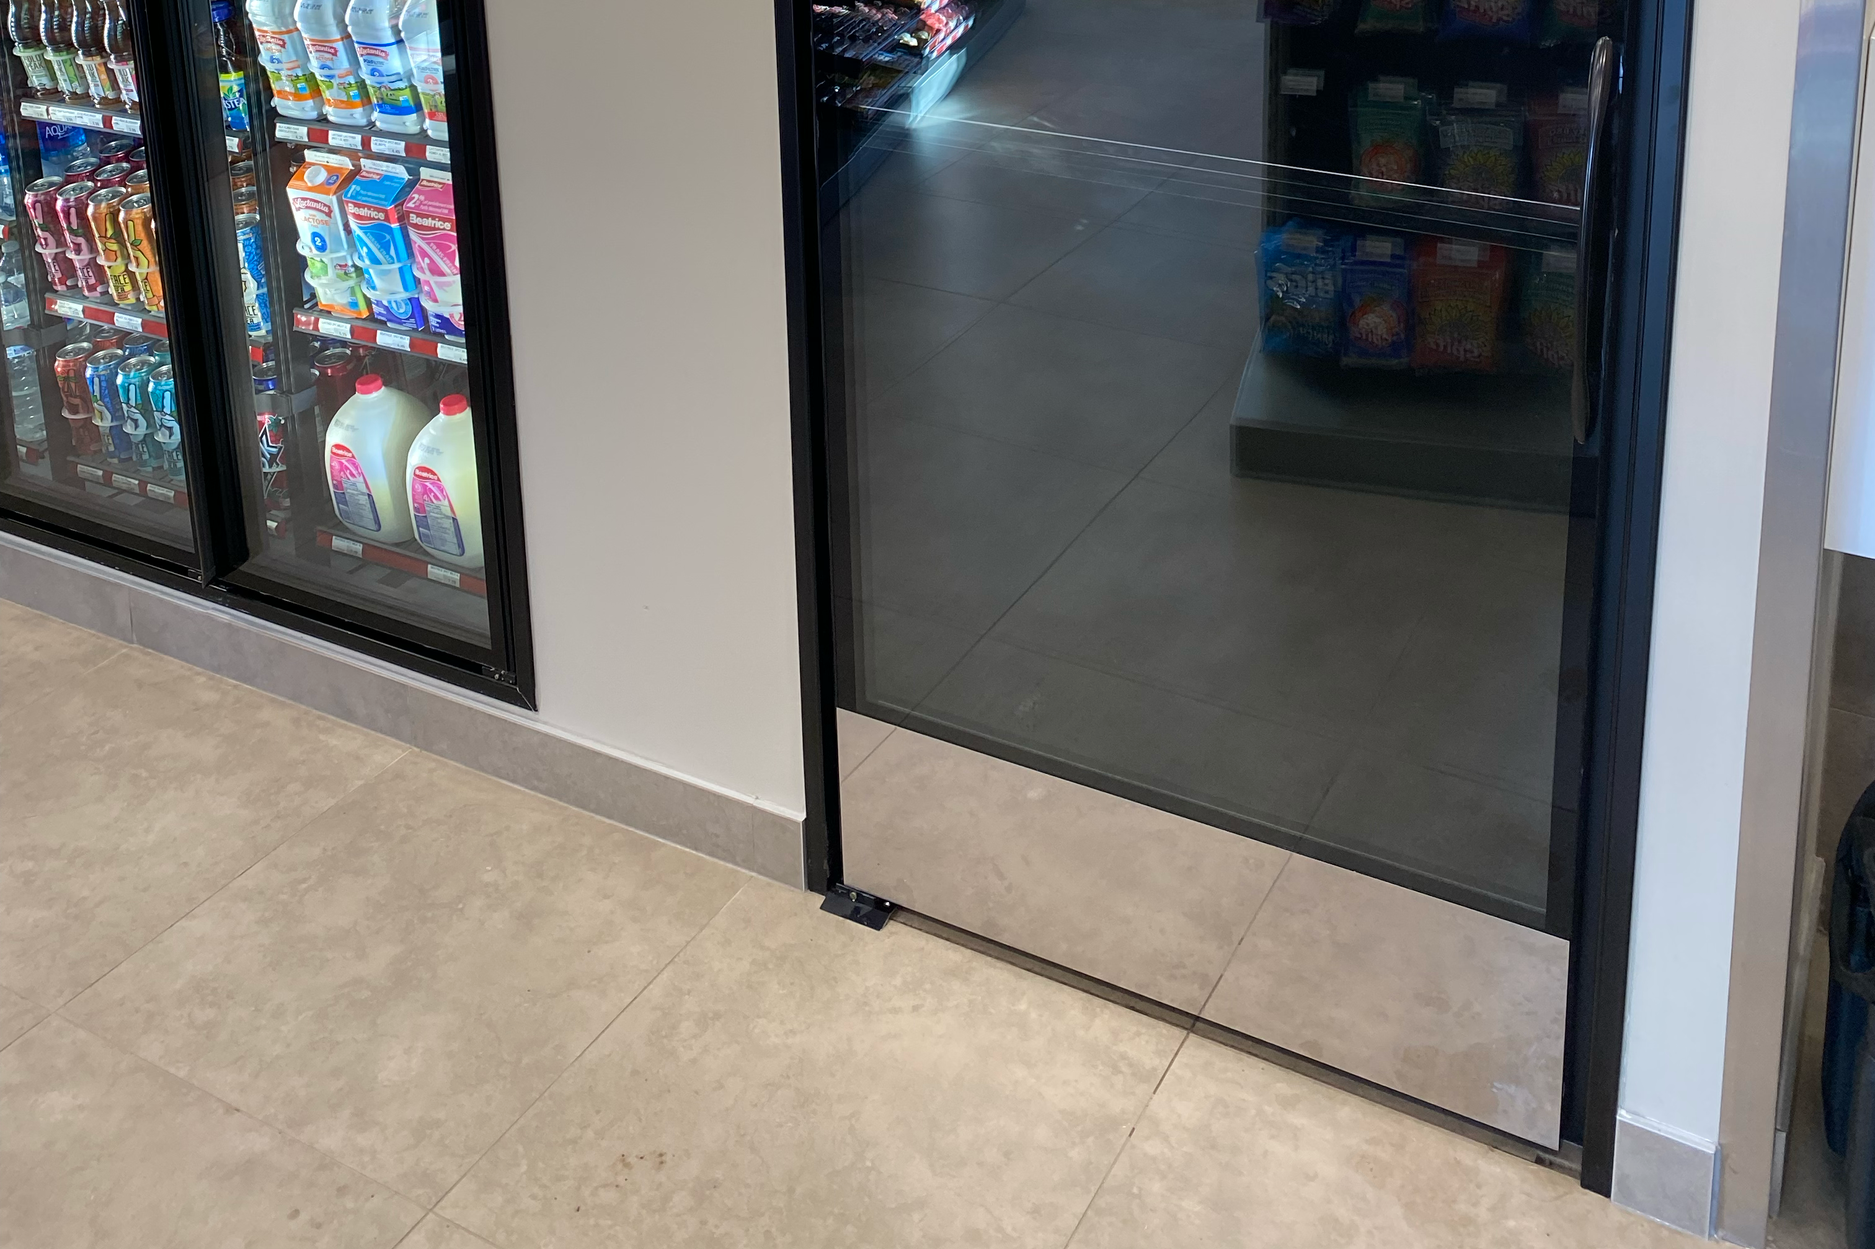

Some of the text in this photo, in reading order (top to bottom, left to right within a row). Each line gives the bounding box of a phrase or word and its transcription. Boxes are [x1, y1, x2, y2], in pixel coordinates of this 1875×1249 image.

[295, 198, 330, 213] Lactantia
[347, 203, 386, 220] Beatrice
[409, 213, 452, 230] Beatrice
